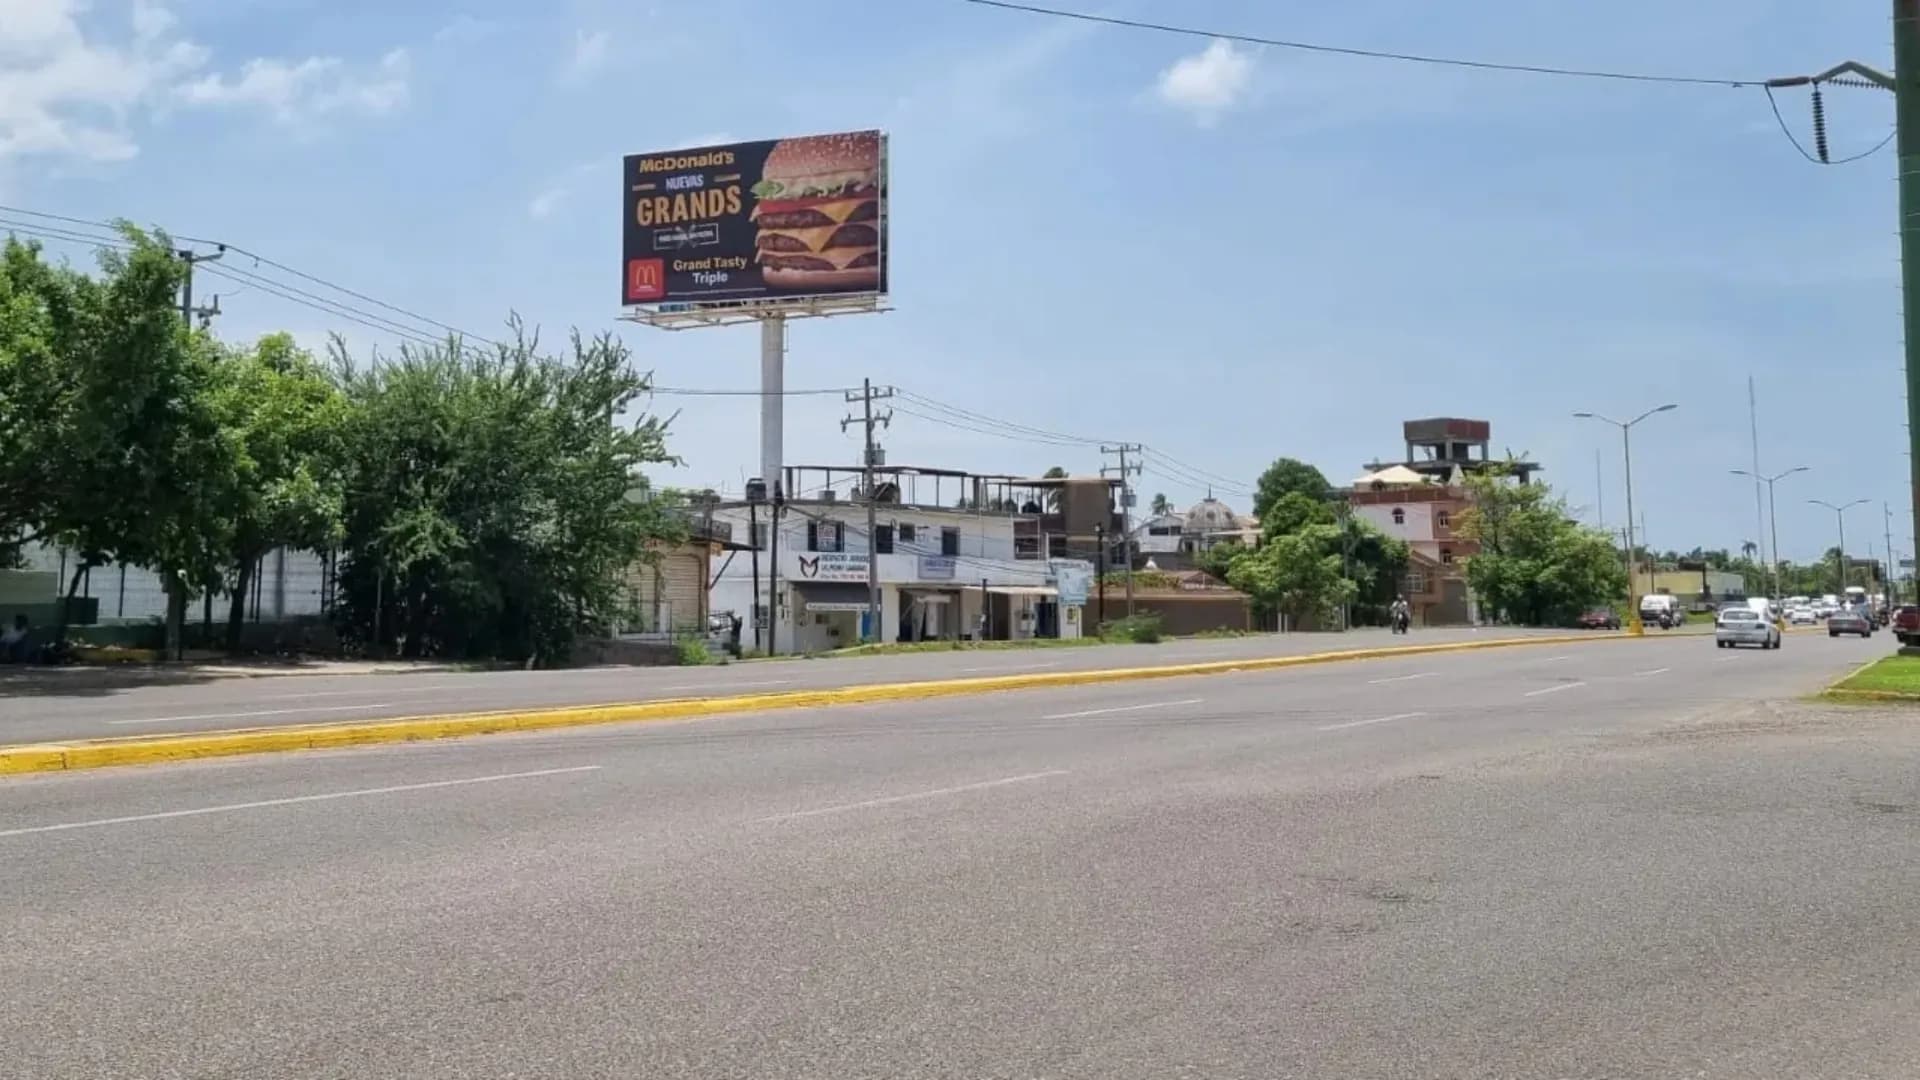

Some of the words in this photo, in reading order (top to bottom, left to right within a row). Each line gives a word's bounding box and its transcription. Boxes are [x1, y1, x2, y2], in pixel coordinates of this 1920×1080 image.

[640, 151, 735, 173] McDonald's
[665, 174, 704, 191] NUEVAS
[637, 185, 742, 227] GRANDS
[673, 257, 712, 271] Grand
[714, 256, 748, 270] Tasty
[692, 271, 729, 286] Triple
